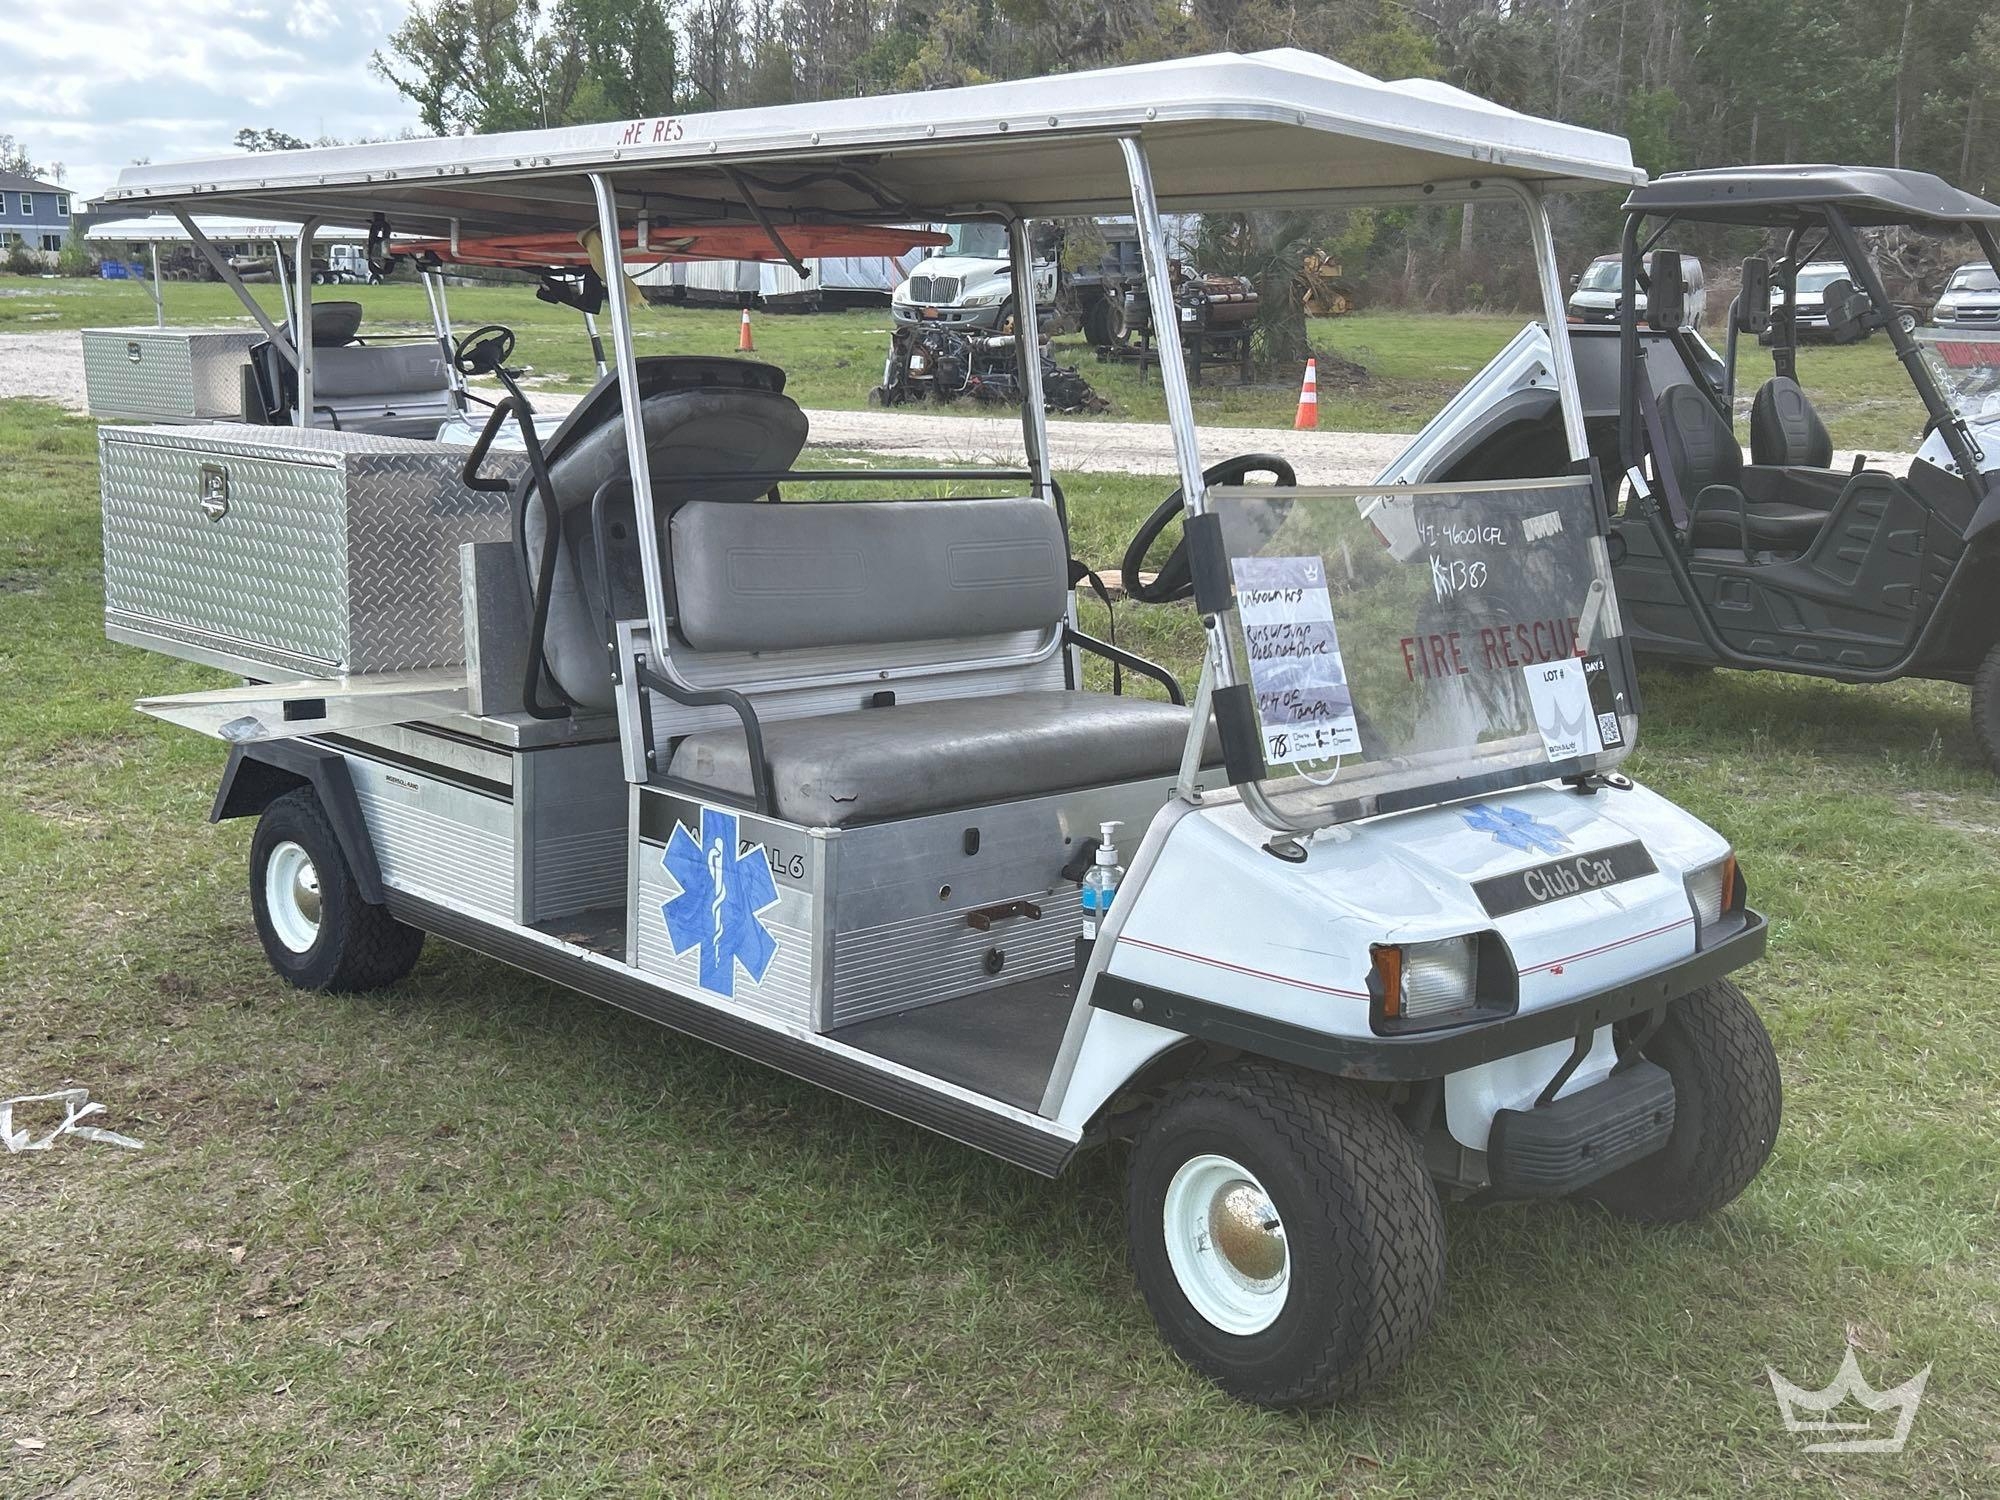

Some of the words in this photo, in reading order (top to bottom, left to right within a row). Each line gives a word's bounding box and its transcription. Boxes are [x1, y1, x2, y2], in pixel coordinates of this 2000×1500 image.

[1251, 641, 1273, 660] Does
[1400, 631, 1470, 682] FIRE
[1480, 616, 1589, 671] RESCUE
[1543, 670, 1558, 682] LOT
[1585, 662, 1600, 673] DAY
[1289, 700, 1330, 720] Tampa
[1268, 733, 1289, 759] 78
[788, 855, 805, 879] 6
[1523, 864, 1580, 901] Club
[1575, 857, 1617, 887] Car
